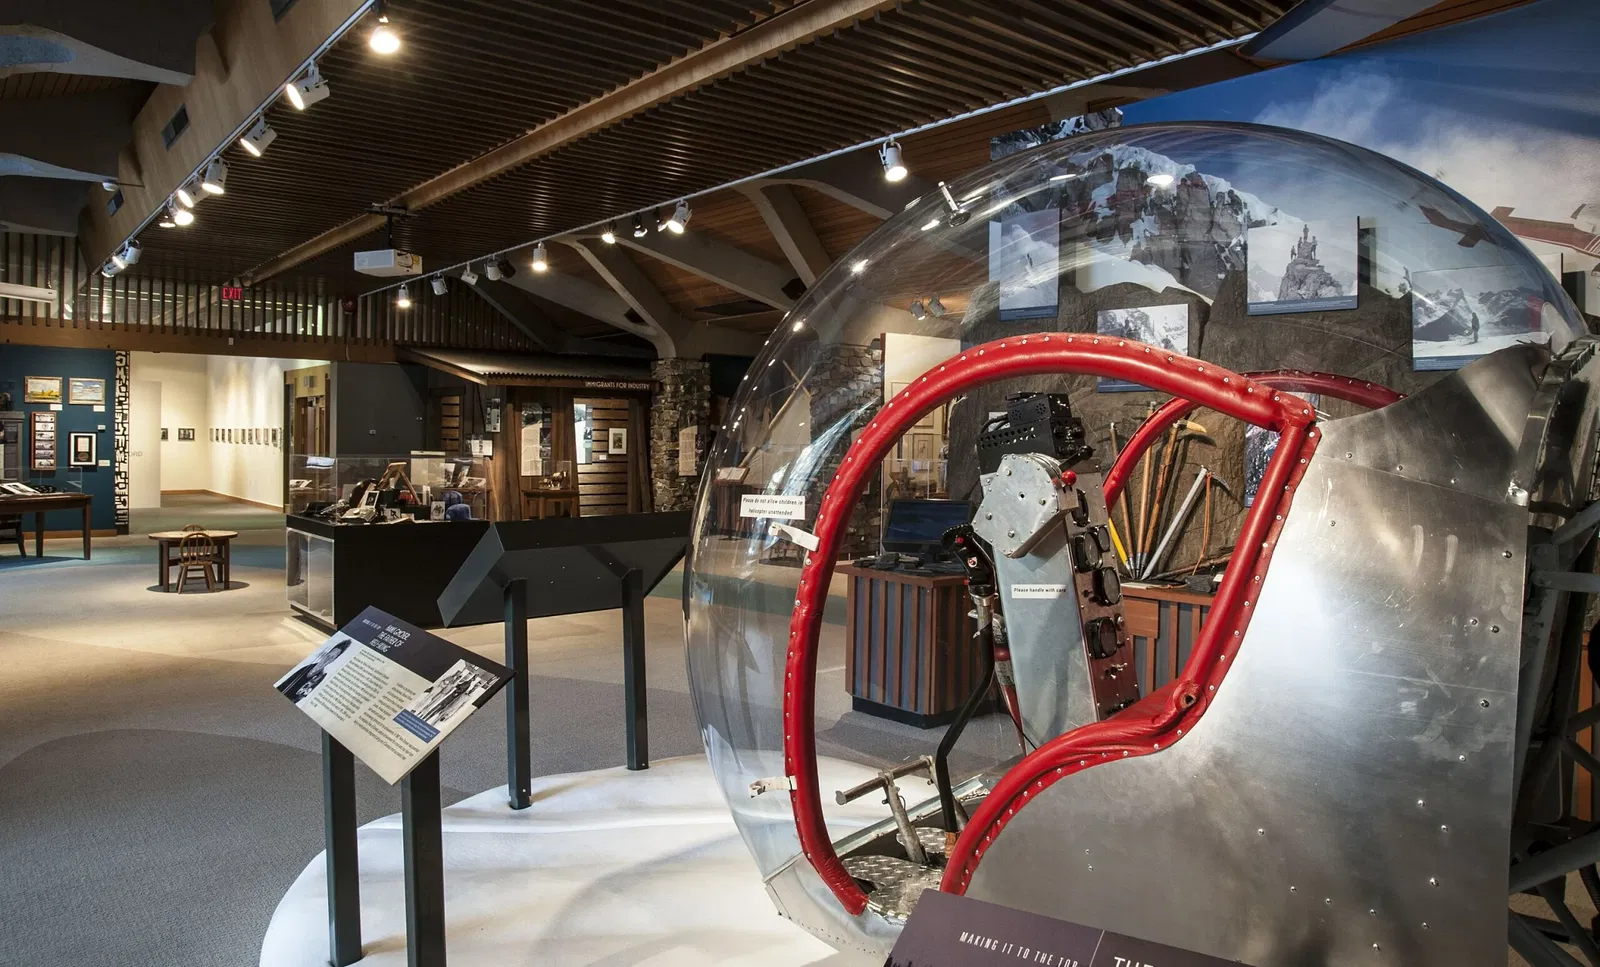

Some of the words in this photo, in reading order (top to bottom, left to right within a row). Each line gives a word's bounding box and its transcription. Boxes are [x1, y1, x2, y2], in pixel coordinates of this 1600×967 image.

[222, 287, 243, 300] EXIT
[628, 382, 650, 390] INDUSTRY
[959, 931, 999, 951] MAKING
[1001, 942, 1014, 955] IT
[1016, 946, 1031, 959] TO
[1033, 950, 1054, 966] THE
[1057, 956, 1079, 967] TOP
